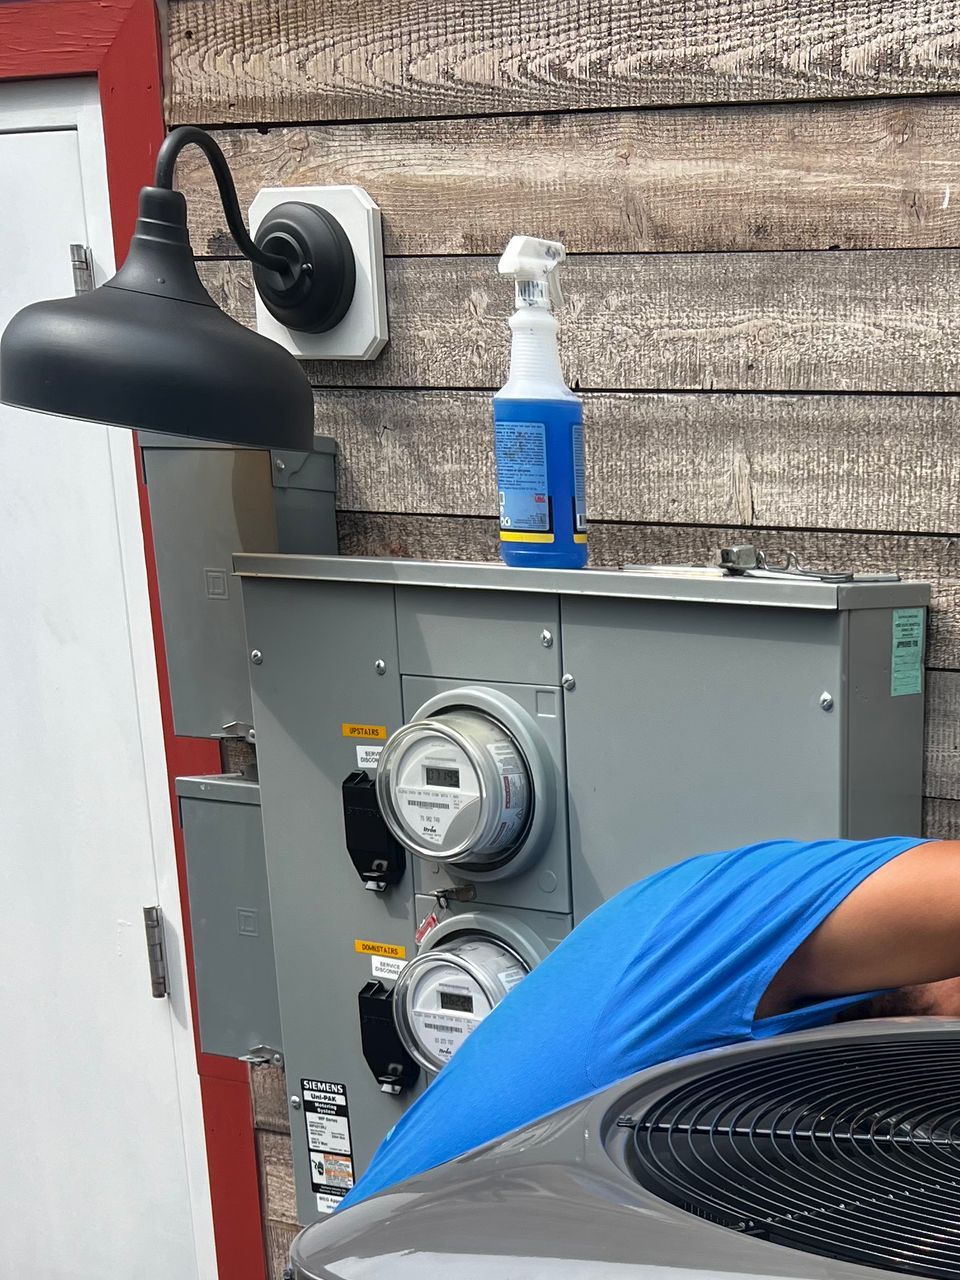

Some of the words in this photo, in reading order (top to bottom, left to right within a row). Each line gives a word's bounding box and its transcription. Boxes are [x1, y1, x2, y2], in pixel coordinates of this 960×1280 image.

[349, 727, 380, 737] UPSTAIRS
[361, 943, 399, 956] DOWNSTAIRS
[379, 961, 400, 970] SERVICE
[303, 1080, 344, 1094] SIEMENS
[310, 1092, 337, 1103] Uni-PAK
[314, 1102, 337, 1111] Metering
[317, 1107, 336, 1115] System
